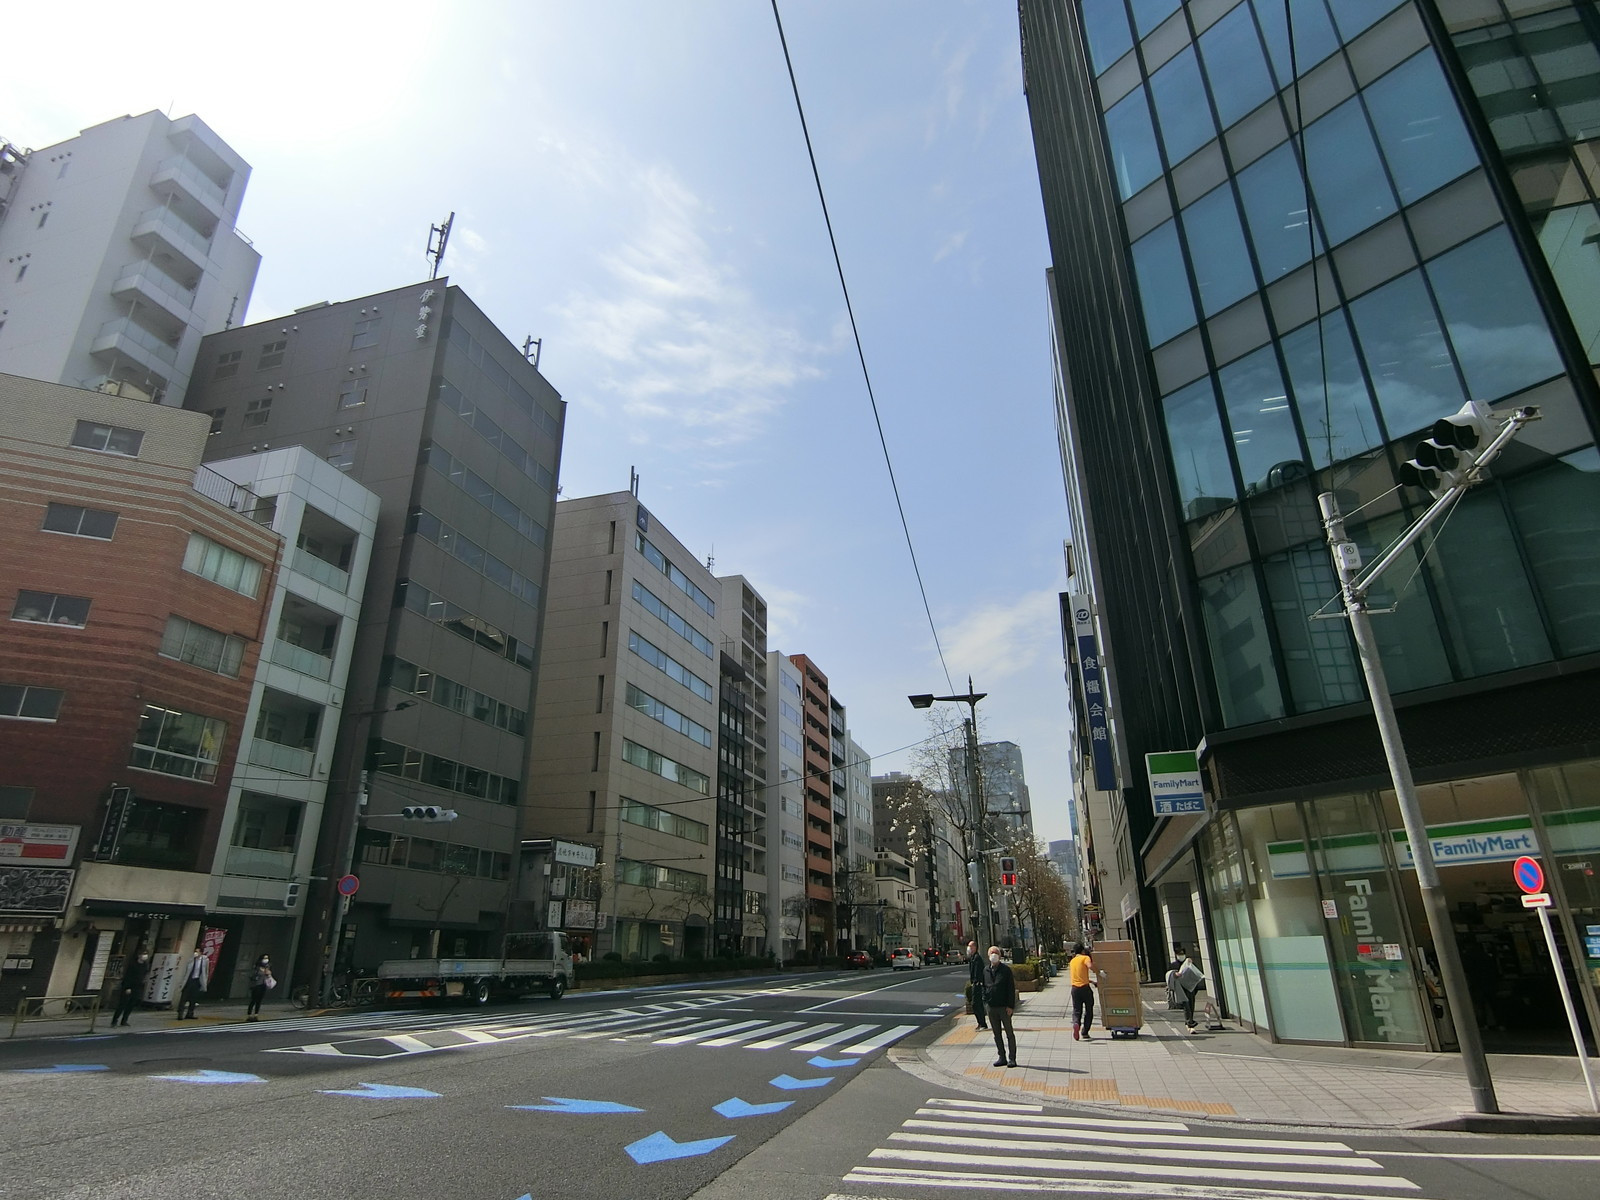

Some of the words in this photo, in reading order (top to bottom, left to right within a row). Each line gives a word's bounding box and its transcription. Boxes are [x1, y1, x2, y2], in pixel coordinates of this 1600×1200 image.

[1083, 656, 1107, 741] 食糧会館
[1153, 779, 1199, 789] FamilyMart
[1160, 801, 1172, 813] 酒
[1176, 801, 1201, 811] たばこ
[1432, 834, 1531, 856] FamilyMart
